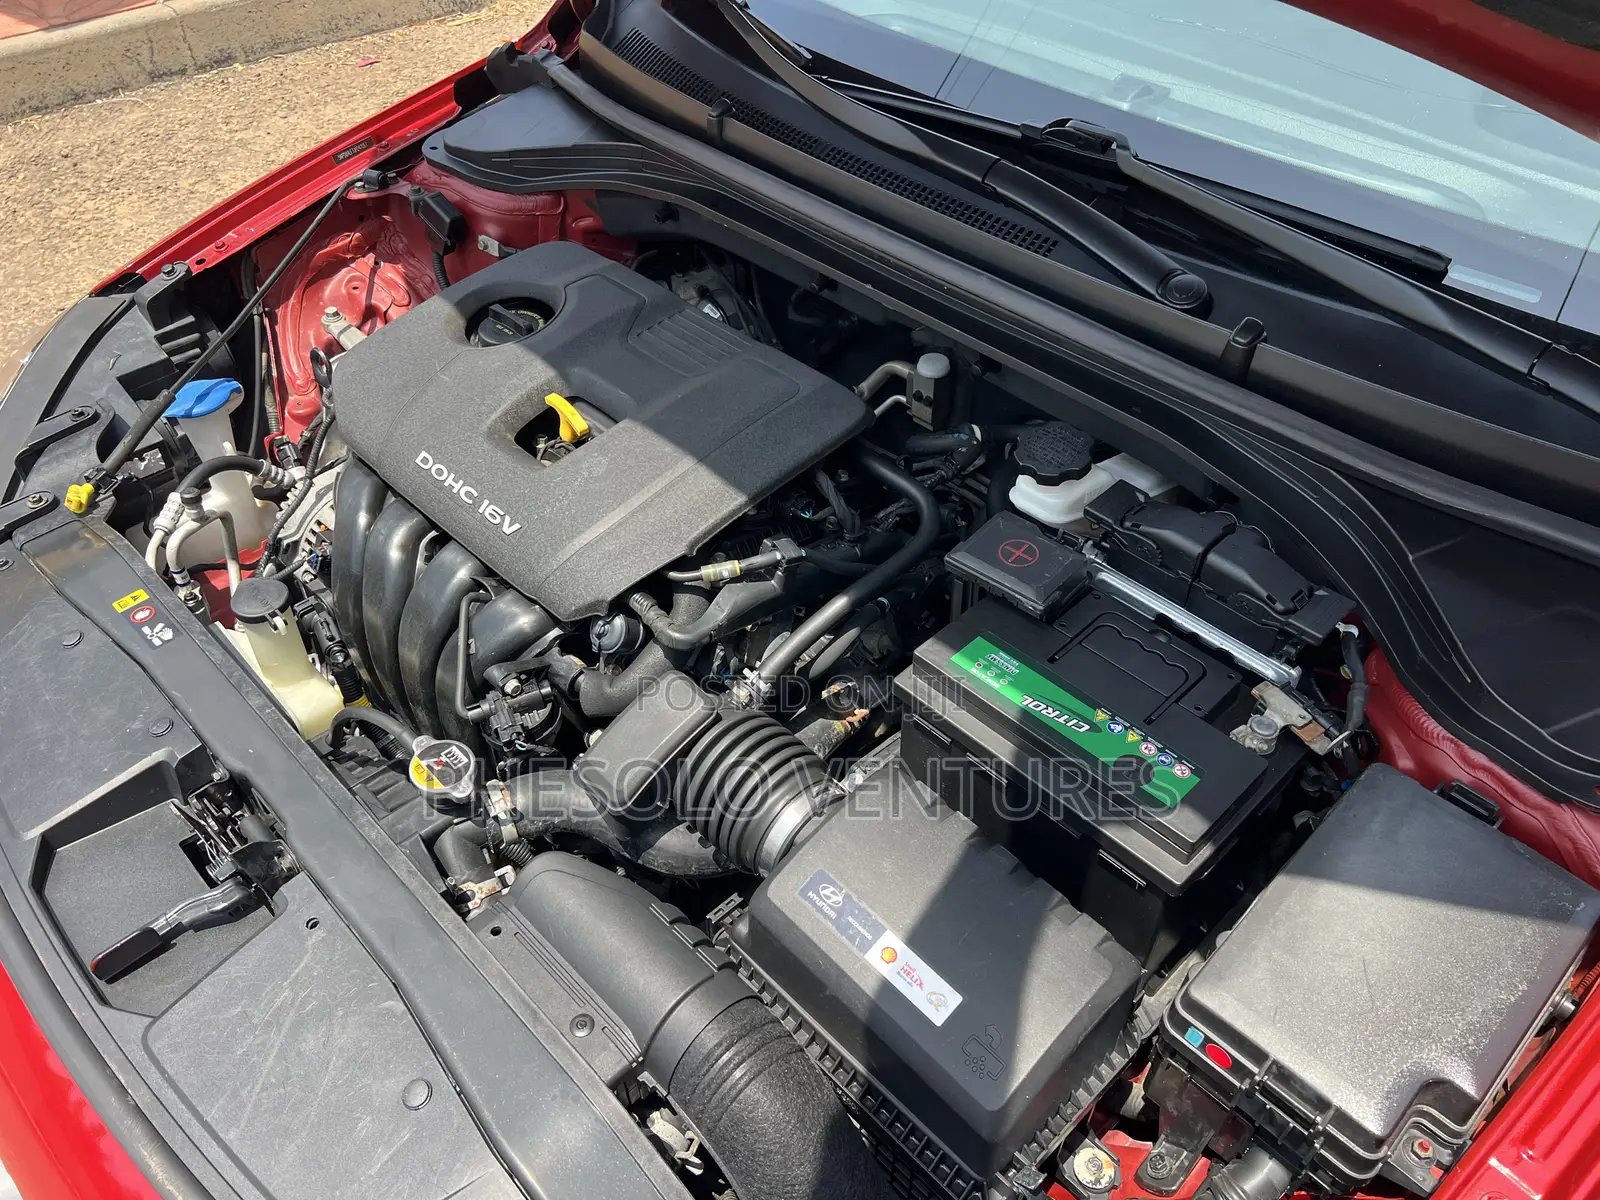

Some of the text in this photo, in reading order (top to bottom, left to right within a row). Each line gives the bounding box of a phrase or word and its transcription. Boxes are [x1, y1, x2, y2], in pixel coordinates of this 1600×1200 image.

[415, 450, 522, 536] DOHC 16V
[1021, 695, 1091, 733] CITROL
[807, 891, 837, 920] HYUNDAI
[900, 966, 924, 990] HELIX
